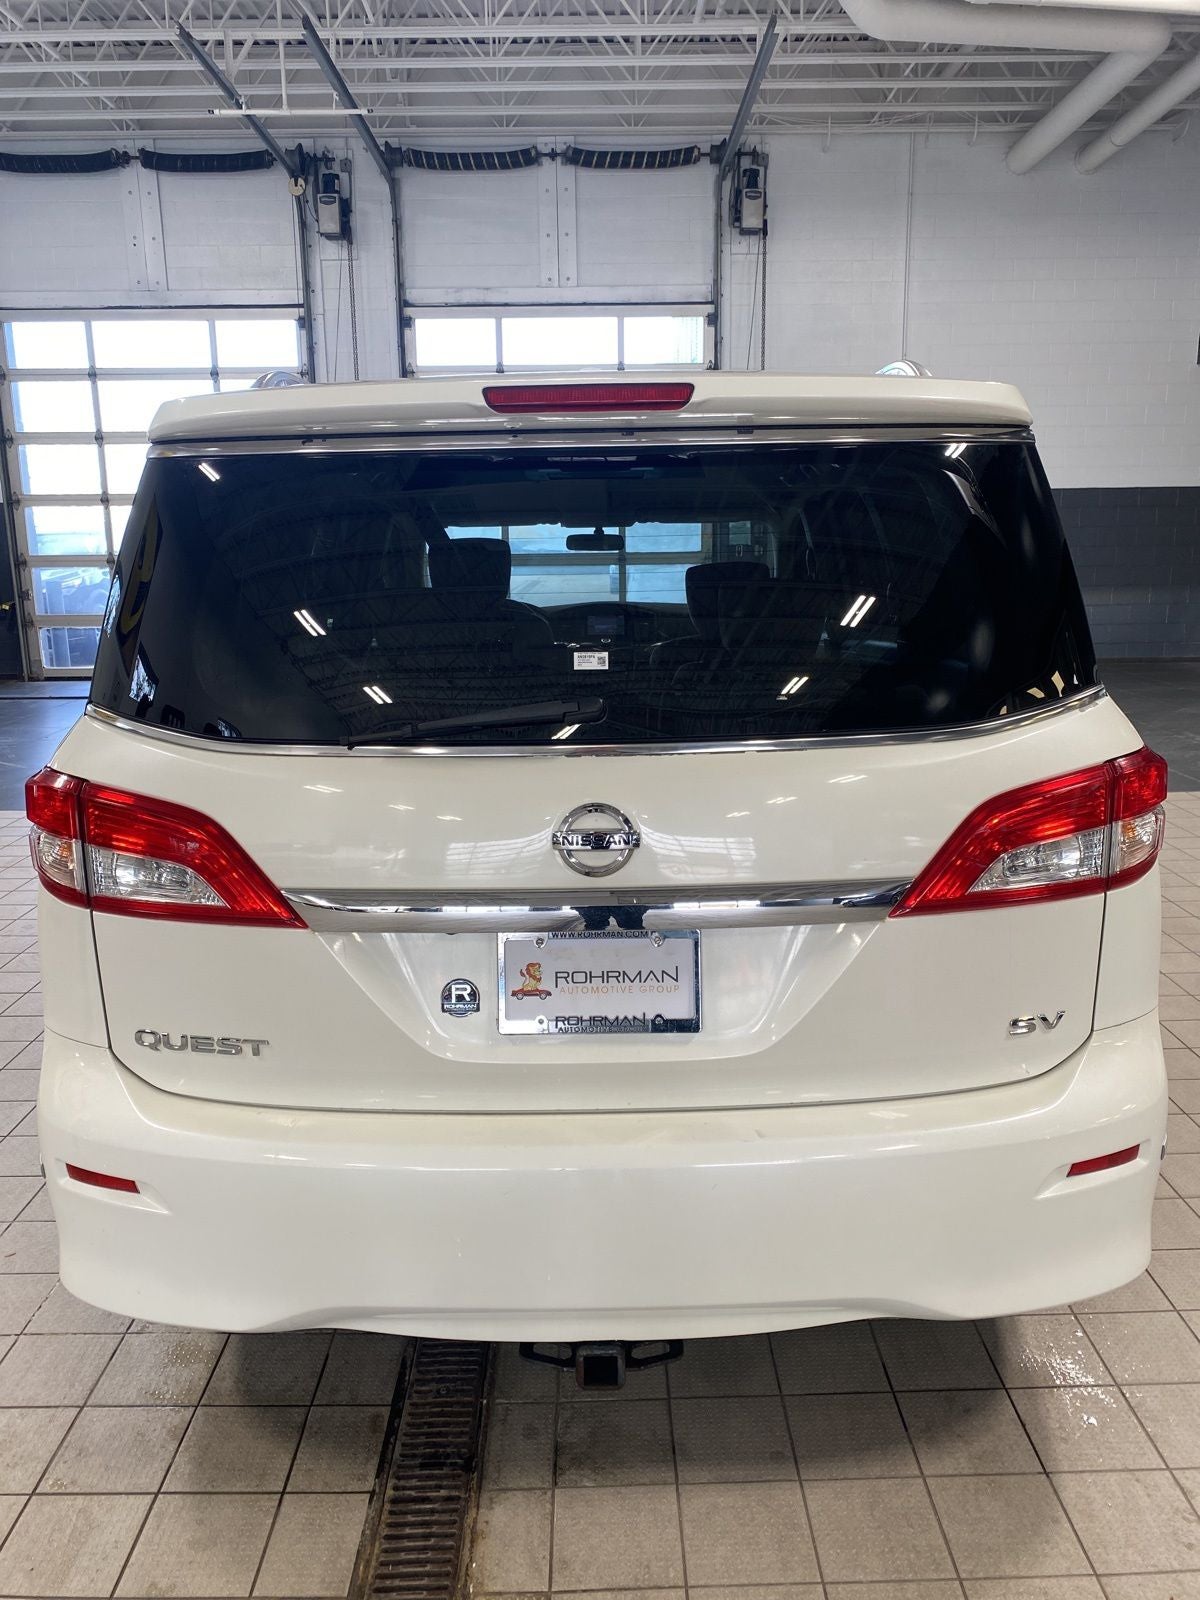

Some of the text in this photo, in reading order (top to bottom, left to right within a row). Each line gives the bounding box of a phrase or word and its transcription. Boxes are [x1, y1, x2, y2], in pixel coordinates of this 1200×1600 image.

[561, 834, 631, 847] NISSAN
[555, 966, 679, 988] ROHRMAN
[451, 984, 471, 1003] R
[559, 985, 680, 995] AUTOMOTIVE GROUP
[555, 1012, 646, 1028] ROHRMAN
[1008, 1010, 1066, 1036] SV
[134, 1028, 270, 1057] QUEST
